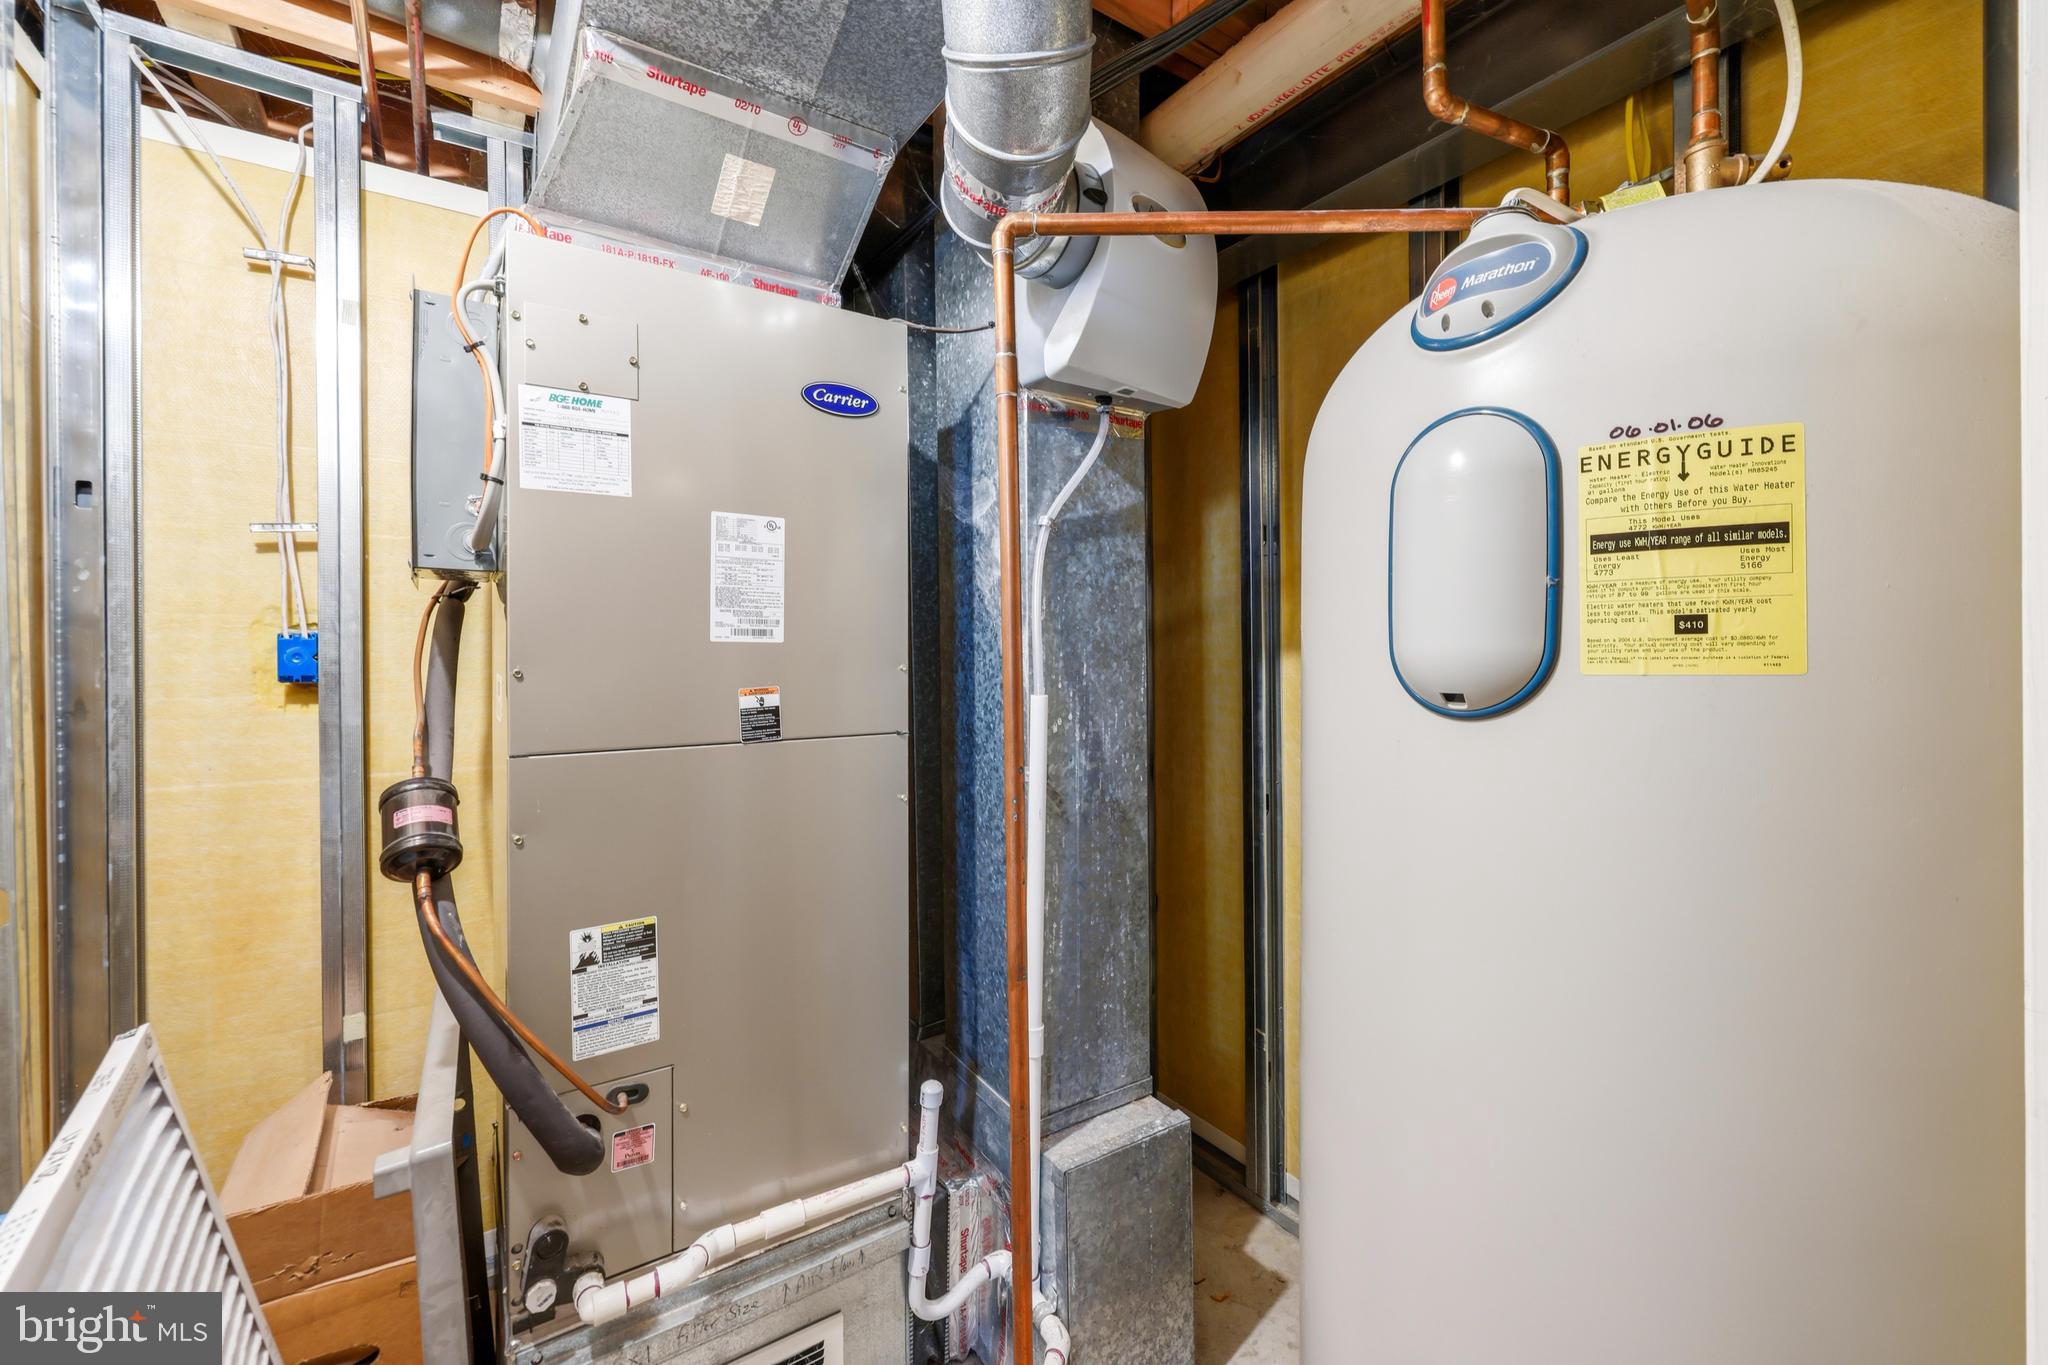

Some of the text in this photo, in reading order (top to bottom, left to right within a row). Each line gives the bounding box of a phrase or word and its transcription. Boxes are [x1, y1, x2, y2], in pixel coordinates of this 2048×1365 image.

[1336, 42, 1367, 63] PIPE
[646, 65, 707, 97] Shurtape
[734, 98, 762, 115] 02/10
[1461, 258, 1537, 291] Marathon
[1429, 282, 1457, 308] Rheem
[548, 393, 604, 409] BGE HOME
[812, 388, 869, 409] Carrier
[1108, 414, 1143, 430] Shurtape
[1585, 479, 1794, 506] Compare the Energy Use of this Water Heater
[1620, 494, 1751, 512] with Others Before you Buy.
[1592, 540, 1615, 552] Energy
[1634, 536, 1666, 549] KWH/YEAR
[1670, 537, 1691, 547] range
[1695, 534, 1703, 543] of
[1707, 533, 1720, 542] all
[1724, 530, 1753, 541] similar
[1757, 528, 1787, 539] models.
[1616, 553, 1639, 561] Least
[1740, 554, 1770, 563] Energy
[1740, 561, 1762, 569] 5166
[1593, 562, 1620, 570] Energy
[1733, 605, 1756, 613] yearly
[1586, 617, 1617, 625] operating
[1678, 620, 1703, 629] $410
[597, 960, 629, 968] INSTALLATION
[959, 1227, 970, 1274] Shurtape
